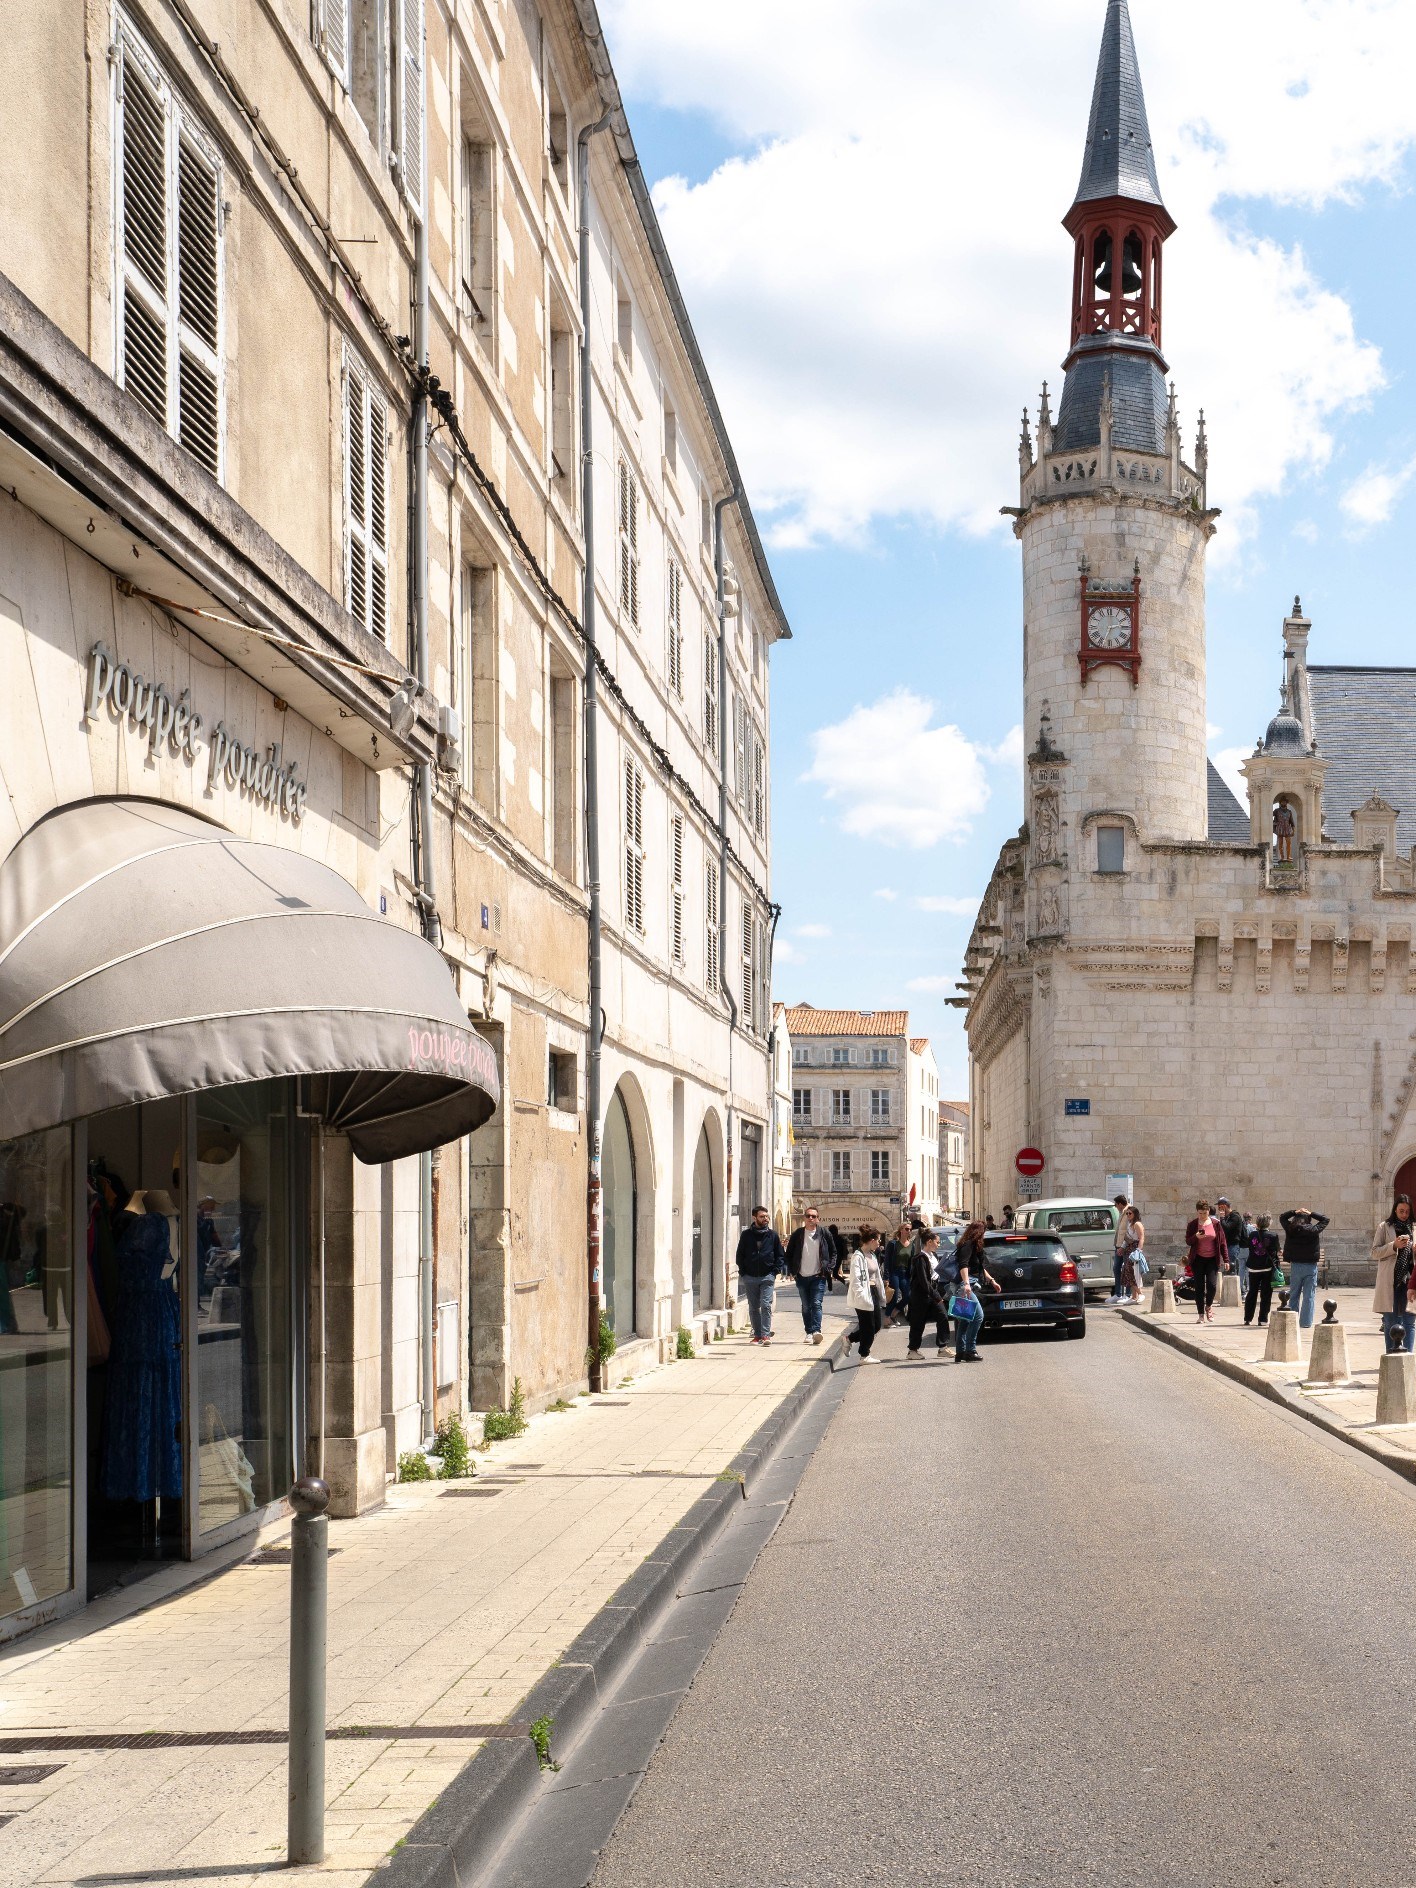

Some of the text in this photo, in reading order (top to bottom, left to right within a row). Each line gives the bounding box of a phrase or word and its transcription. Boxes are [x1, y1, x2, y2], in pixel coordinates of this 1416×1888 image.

[86, 640, 308, 819] poupée poudrée
[408, 1025, 467, 1073] poupée
